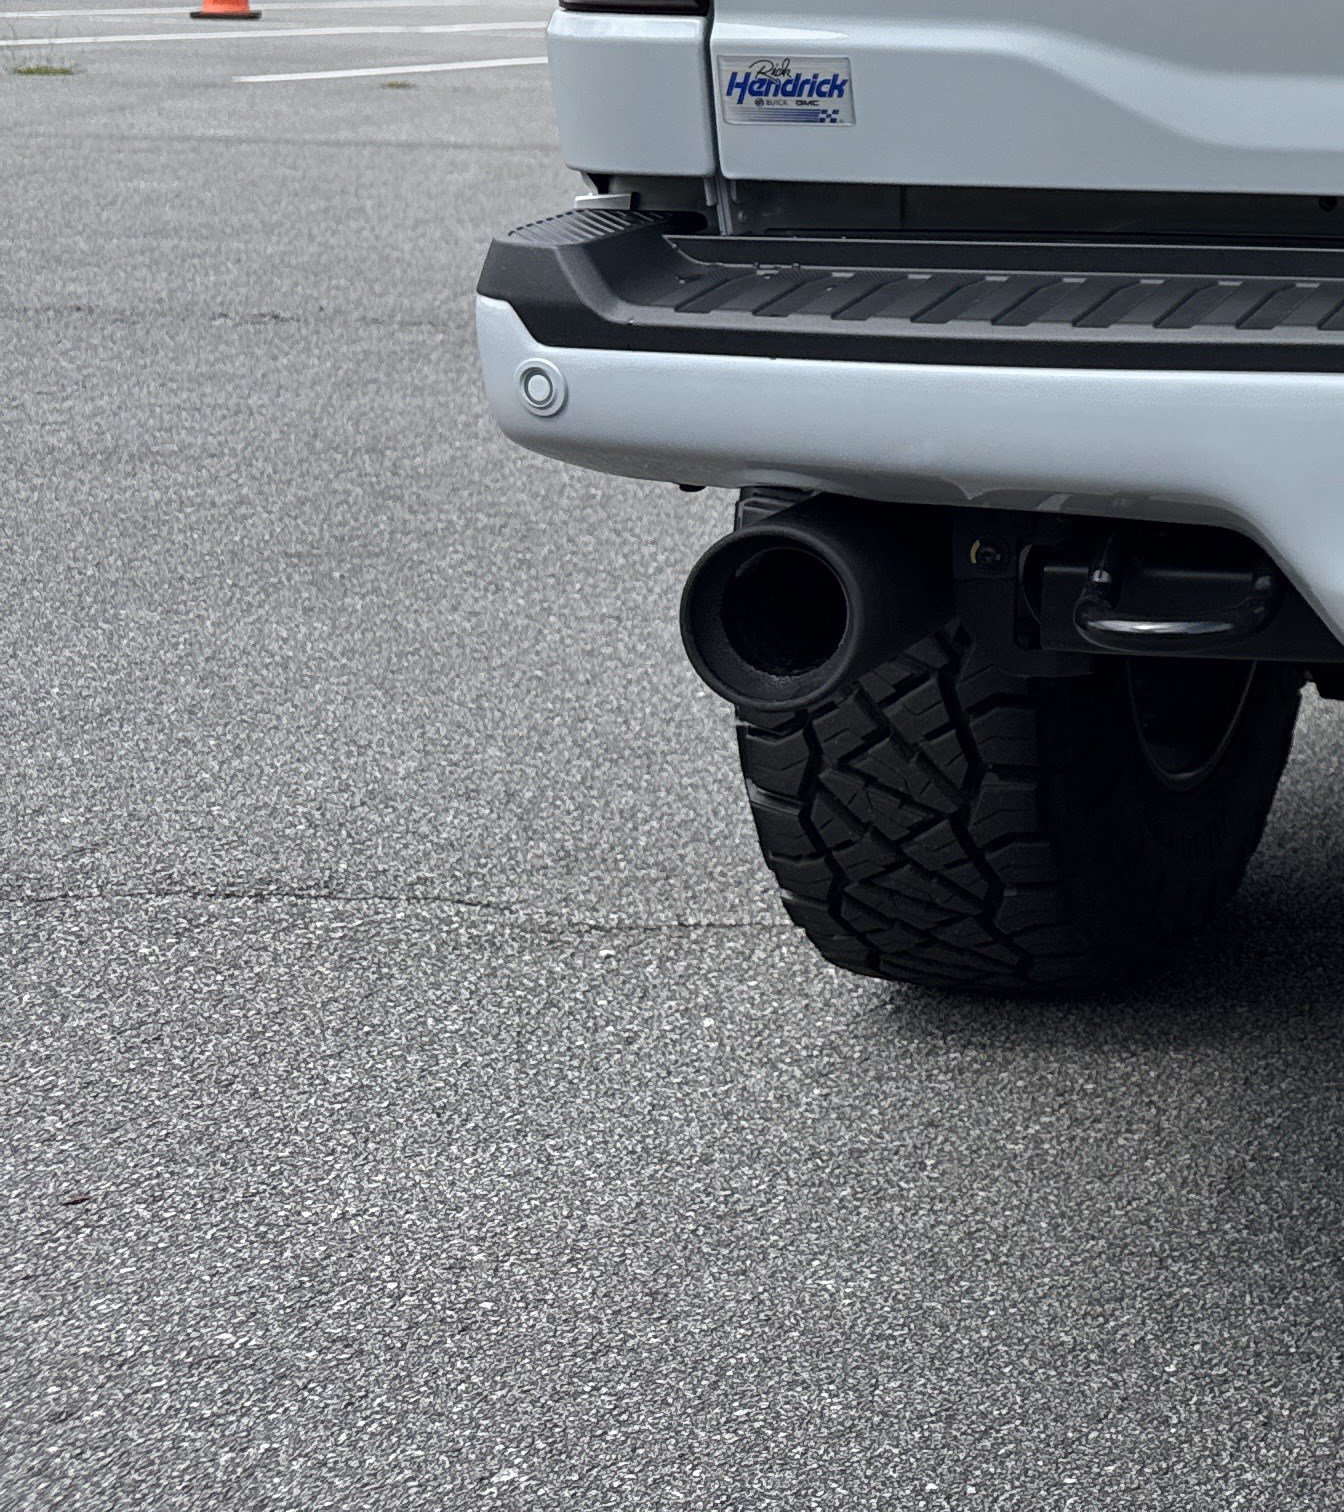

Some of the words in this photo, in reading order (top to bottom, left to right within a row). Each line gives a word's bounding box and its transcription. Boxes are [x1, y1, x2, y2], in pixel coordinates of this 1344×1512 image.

[748, 58, 791, 82] Rick
[726, 71, 848, 105] Hendrick
[795, 99, 820, 107] GMC
